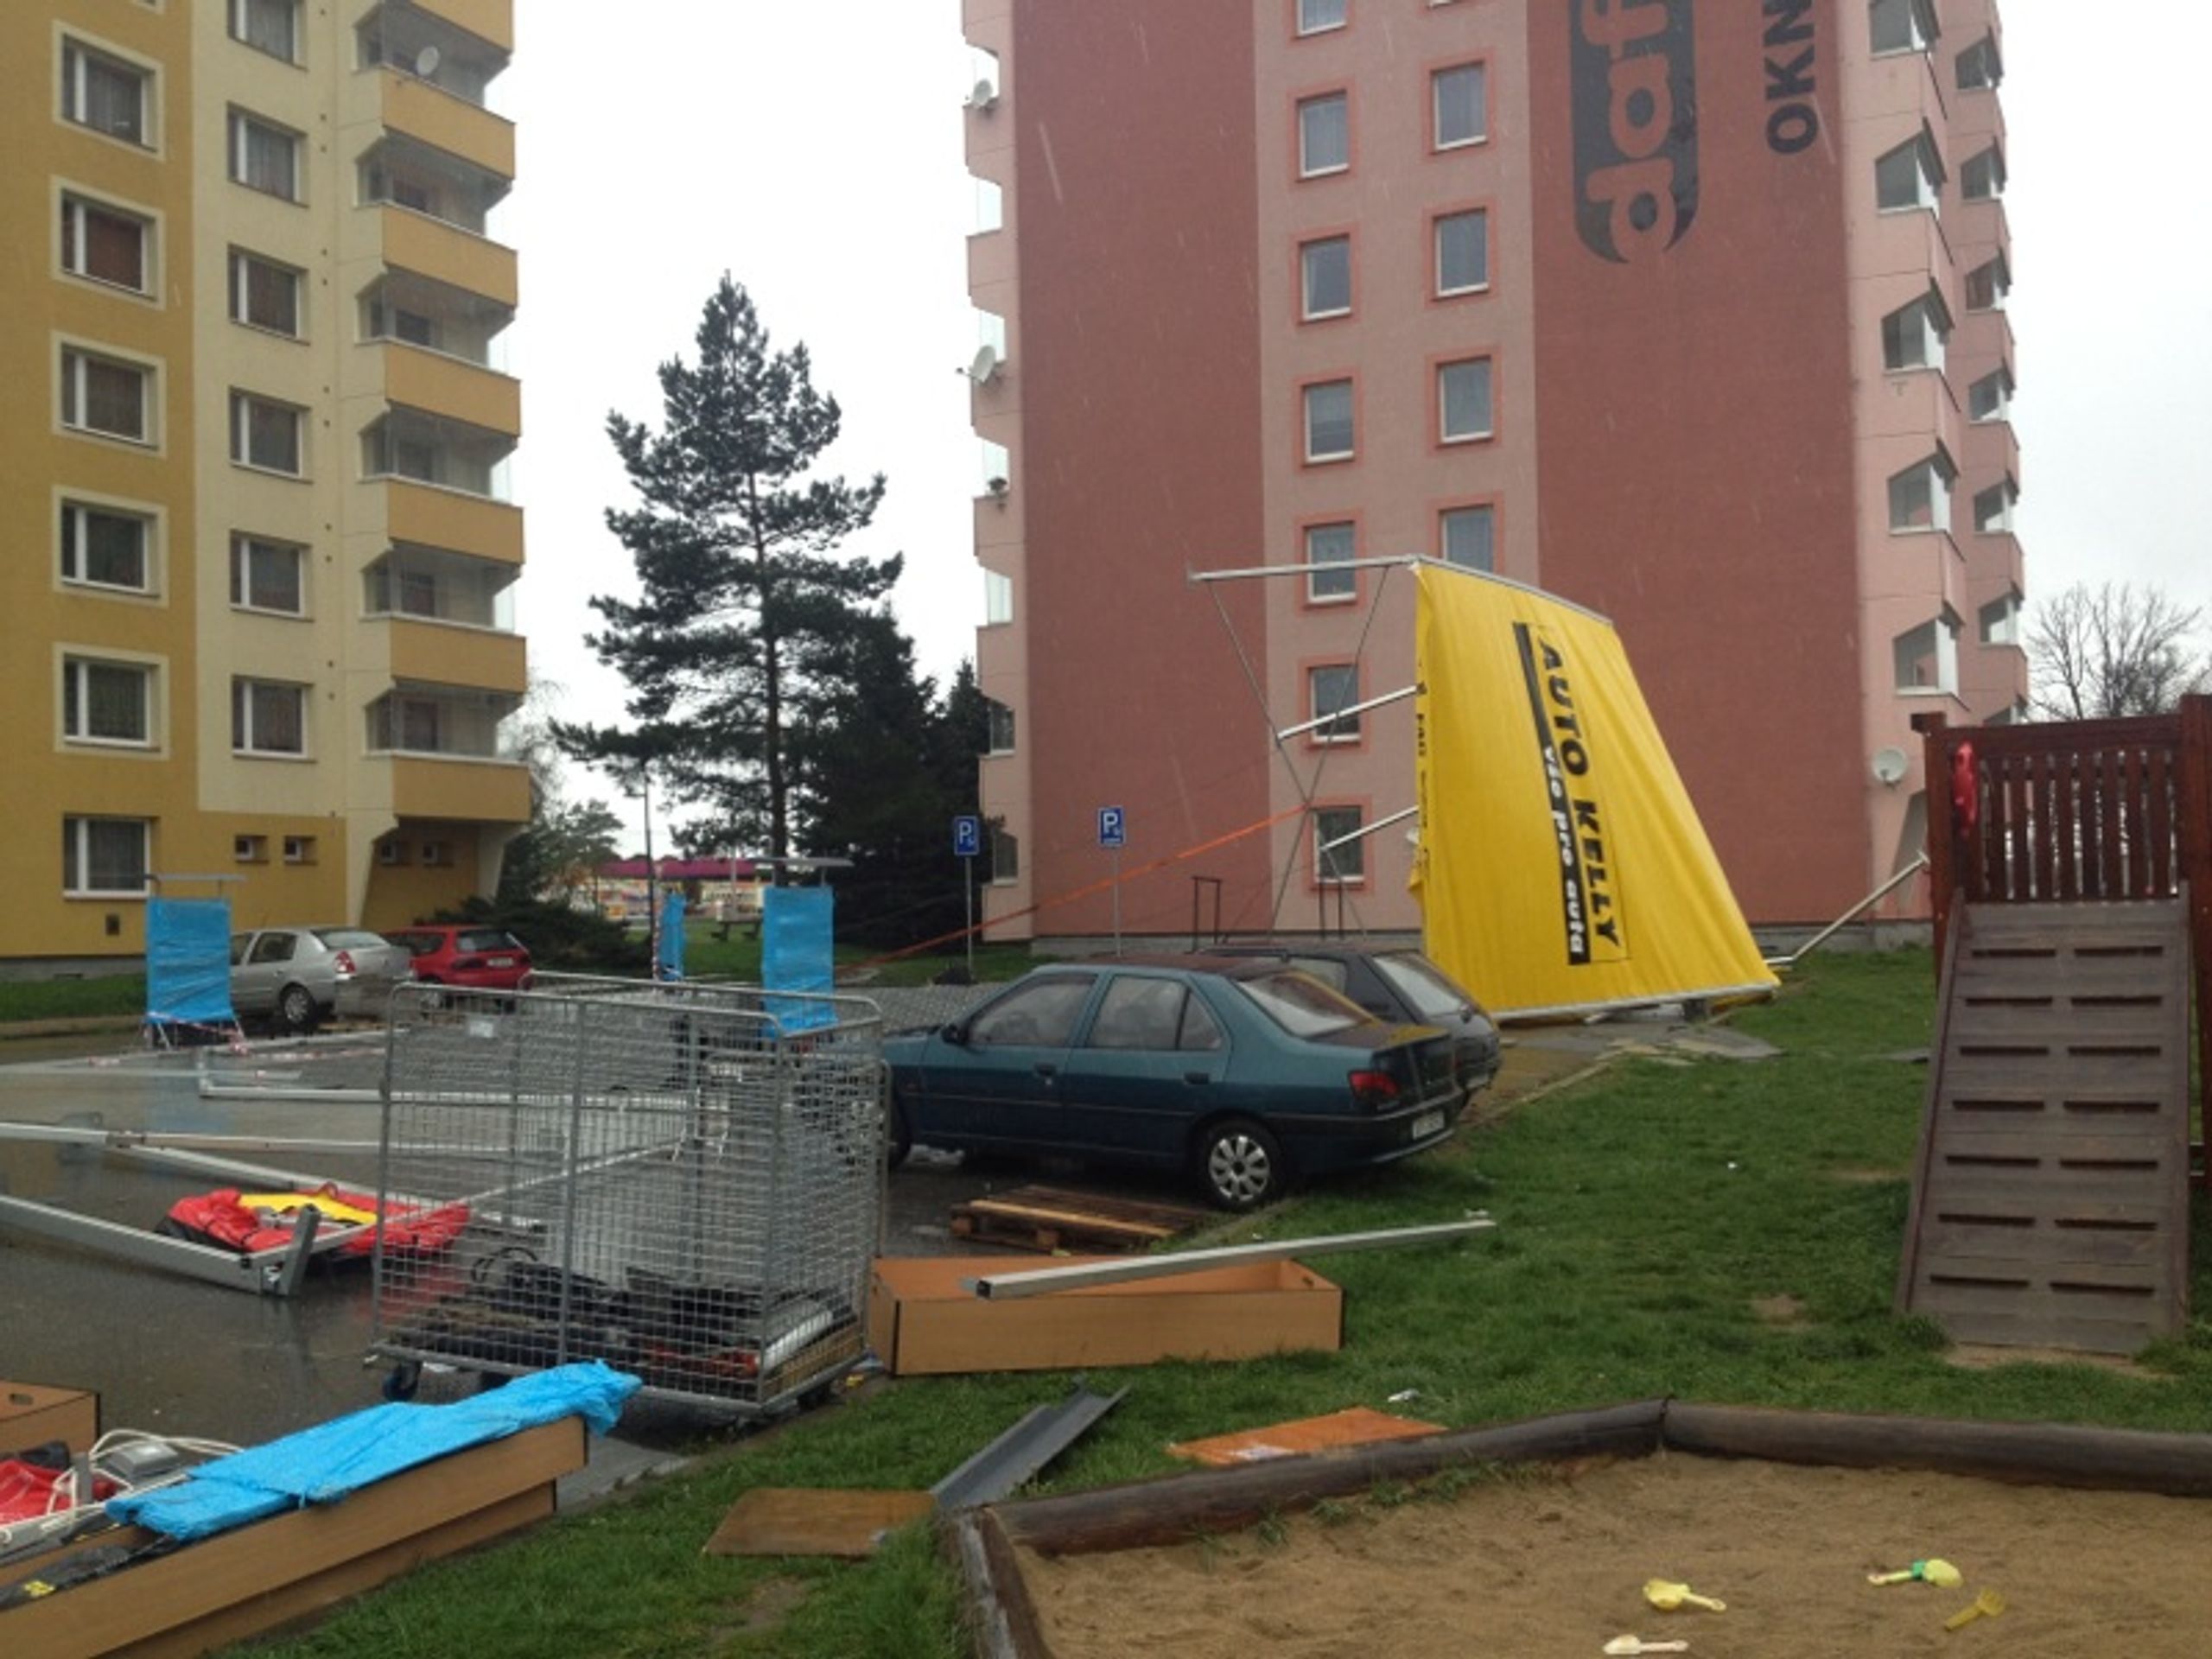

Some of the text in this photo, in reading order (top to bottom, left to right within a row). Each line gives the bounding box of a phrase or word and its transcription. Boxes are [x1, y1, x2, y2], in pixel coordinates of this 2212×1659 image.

[958, 822, 972, 844] P
[1103, 812, 1118, 835] P
[1539, 639, 1619, 947] AUTO KELLY
[1553, 810, 1573, 867] pro
[1567, 880, 1585, 953] auta
